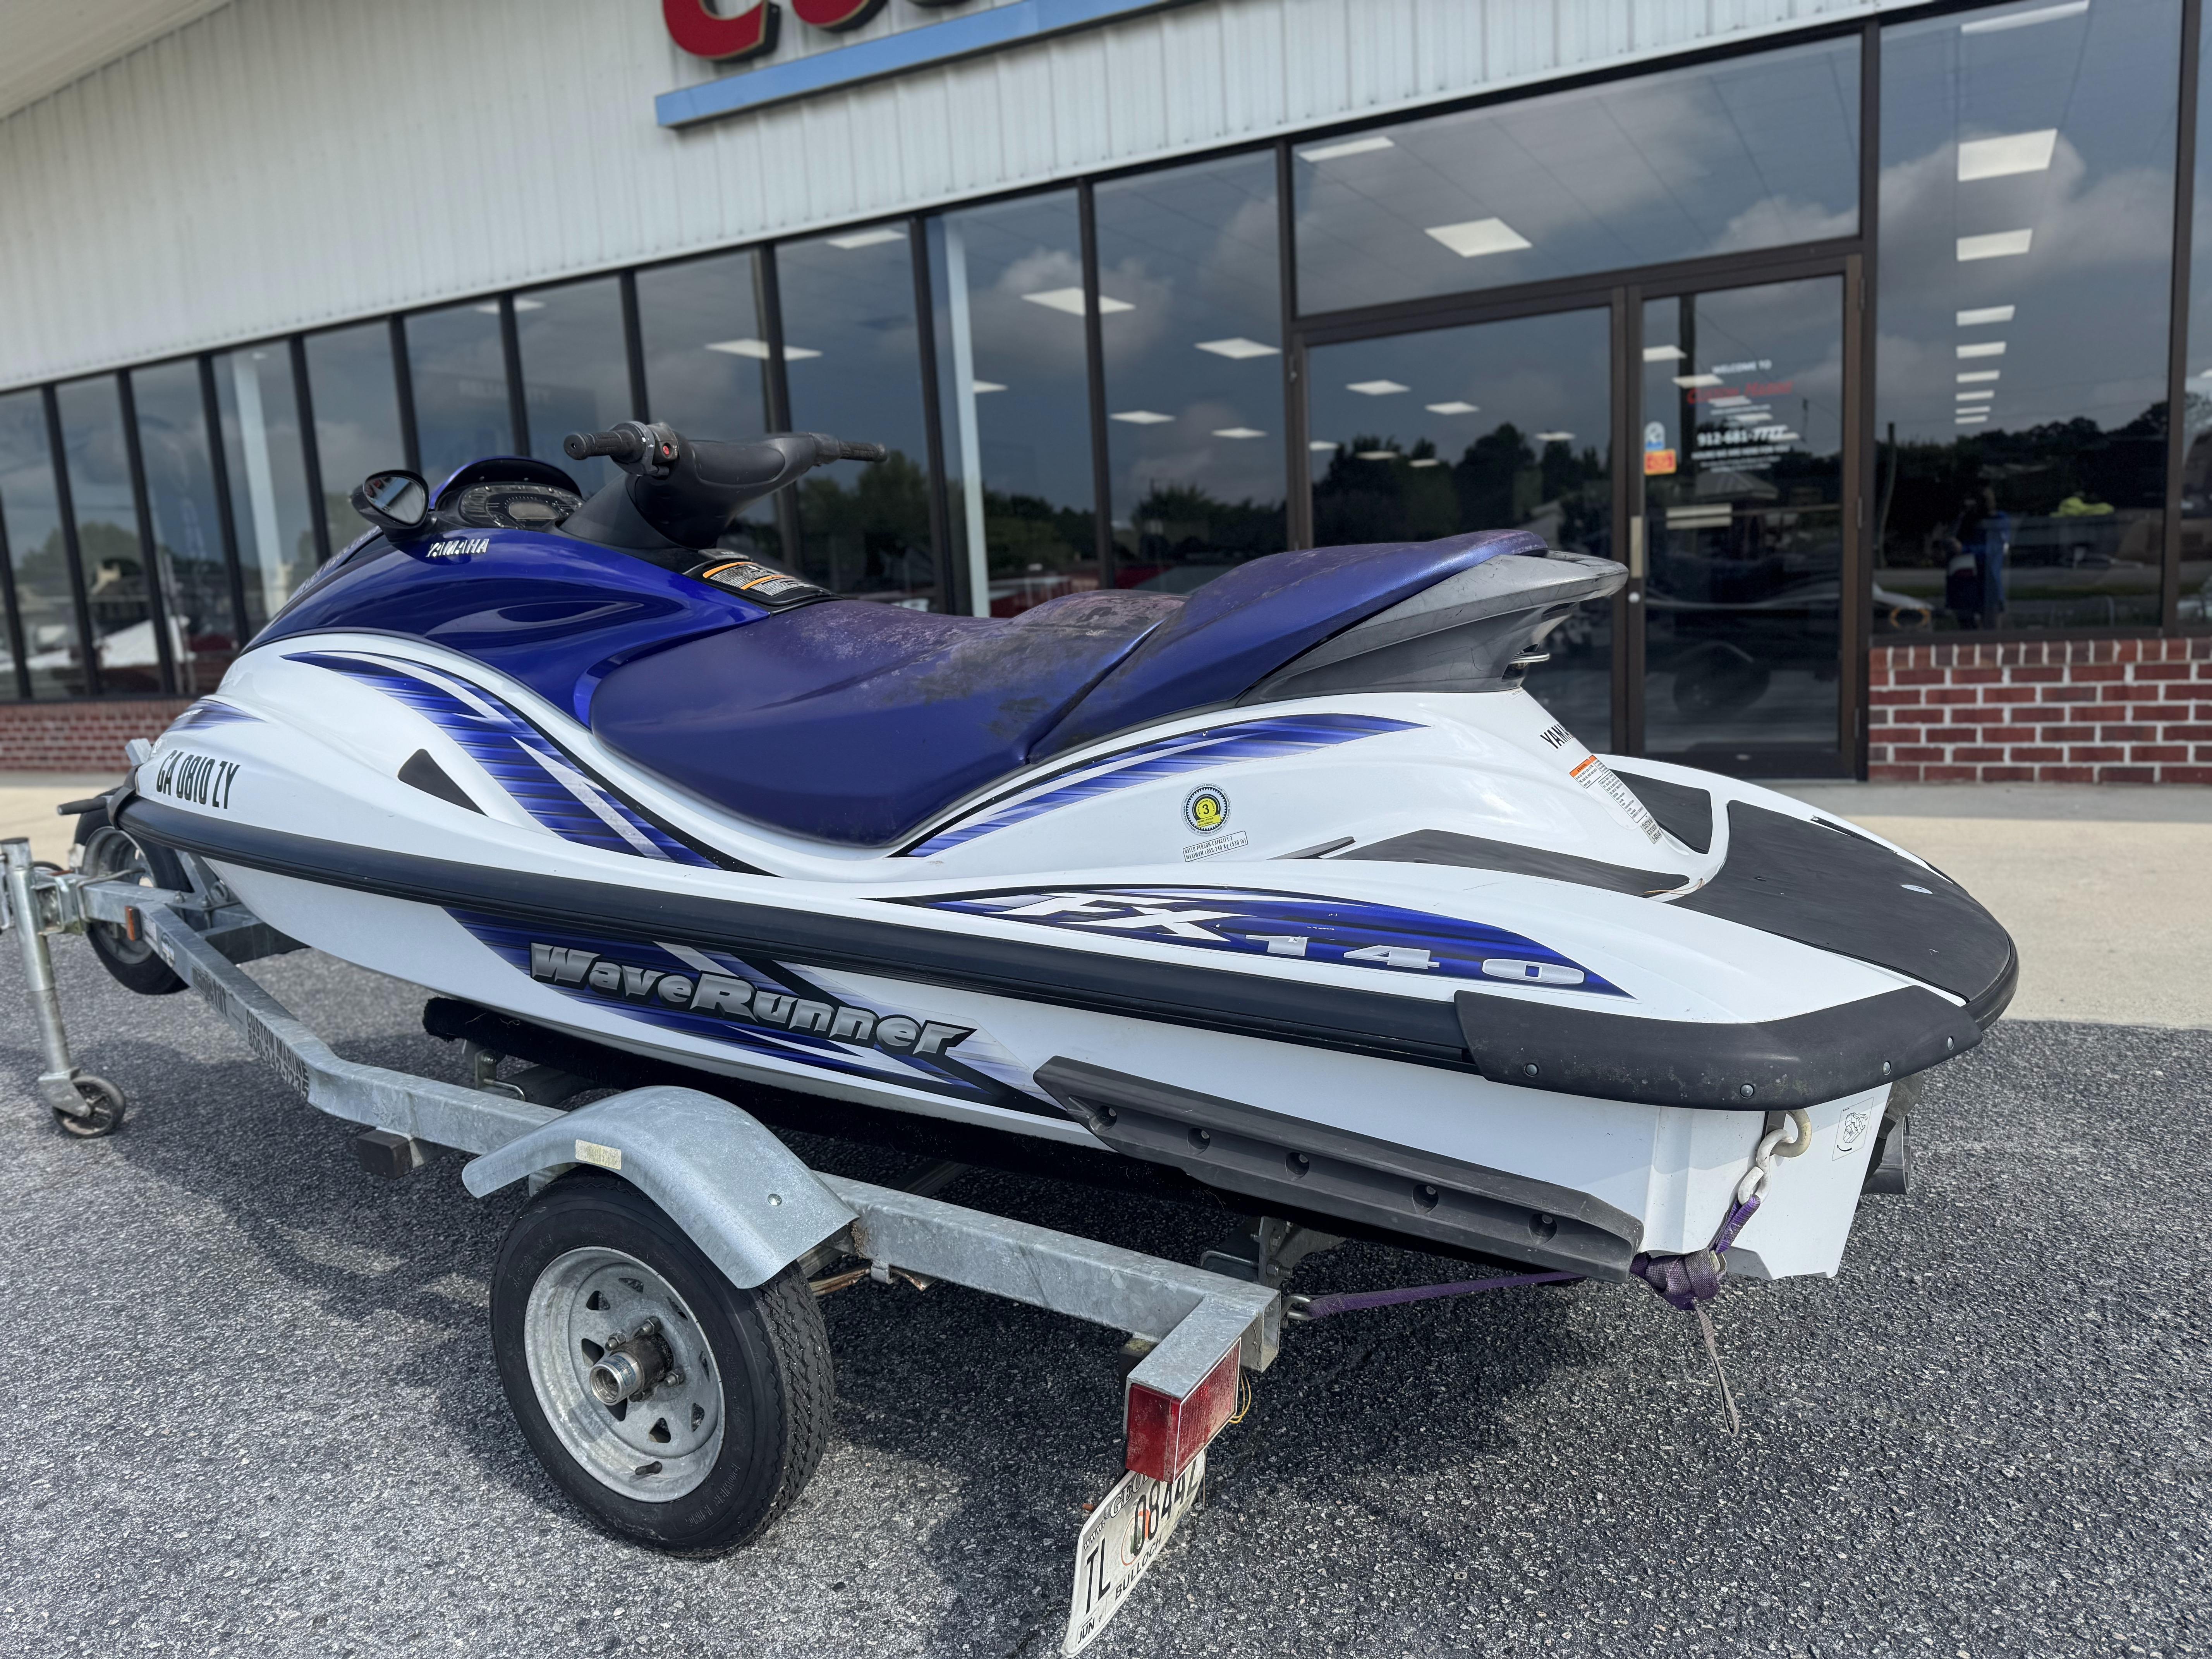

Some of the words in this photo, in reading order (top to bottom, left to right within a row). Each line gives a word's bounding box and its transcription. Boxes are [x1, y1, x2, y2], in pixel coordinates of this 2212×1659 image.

[426, 538, 490, 558] YAMAHA
[156, 749, 185, 796] GA
[176, 754, 216, 805] 0810
[212, 760, 241, 809] ZY
[1202, 804, 1209, 814] 3
[530, 942, 978, 1057] WaveRunner
[246, 1009, 275, 1052] CUSTOM
[275, 1037, 309, 1082] MARINE
[1085, 1537, 1111, 1615] TL
[1115, 1533, 1161, 1601] BULLOCH
[1078, 1617, 1095, 1644] JUN
